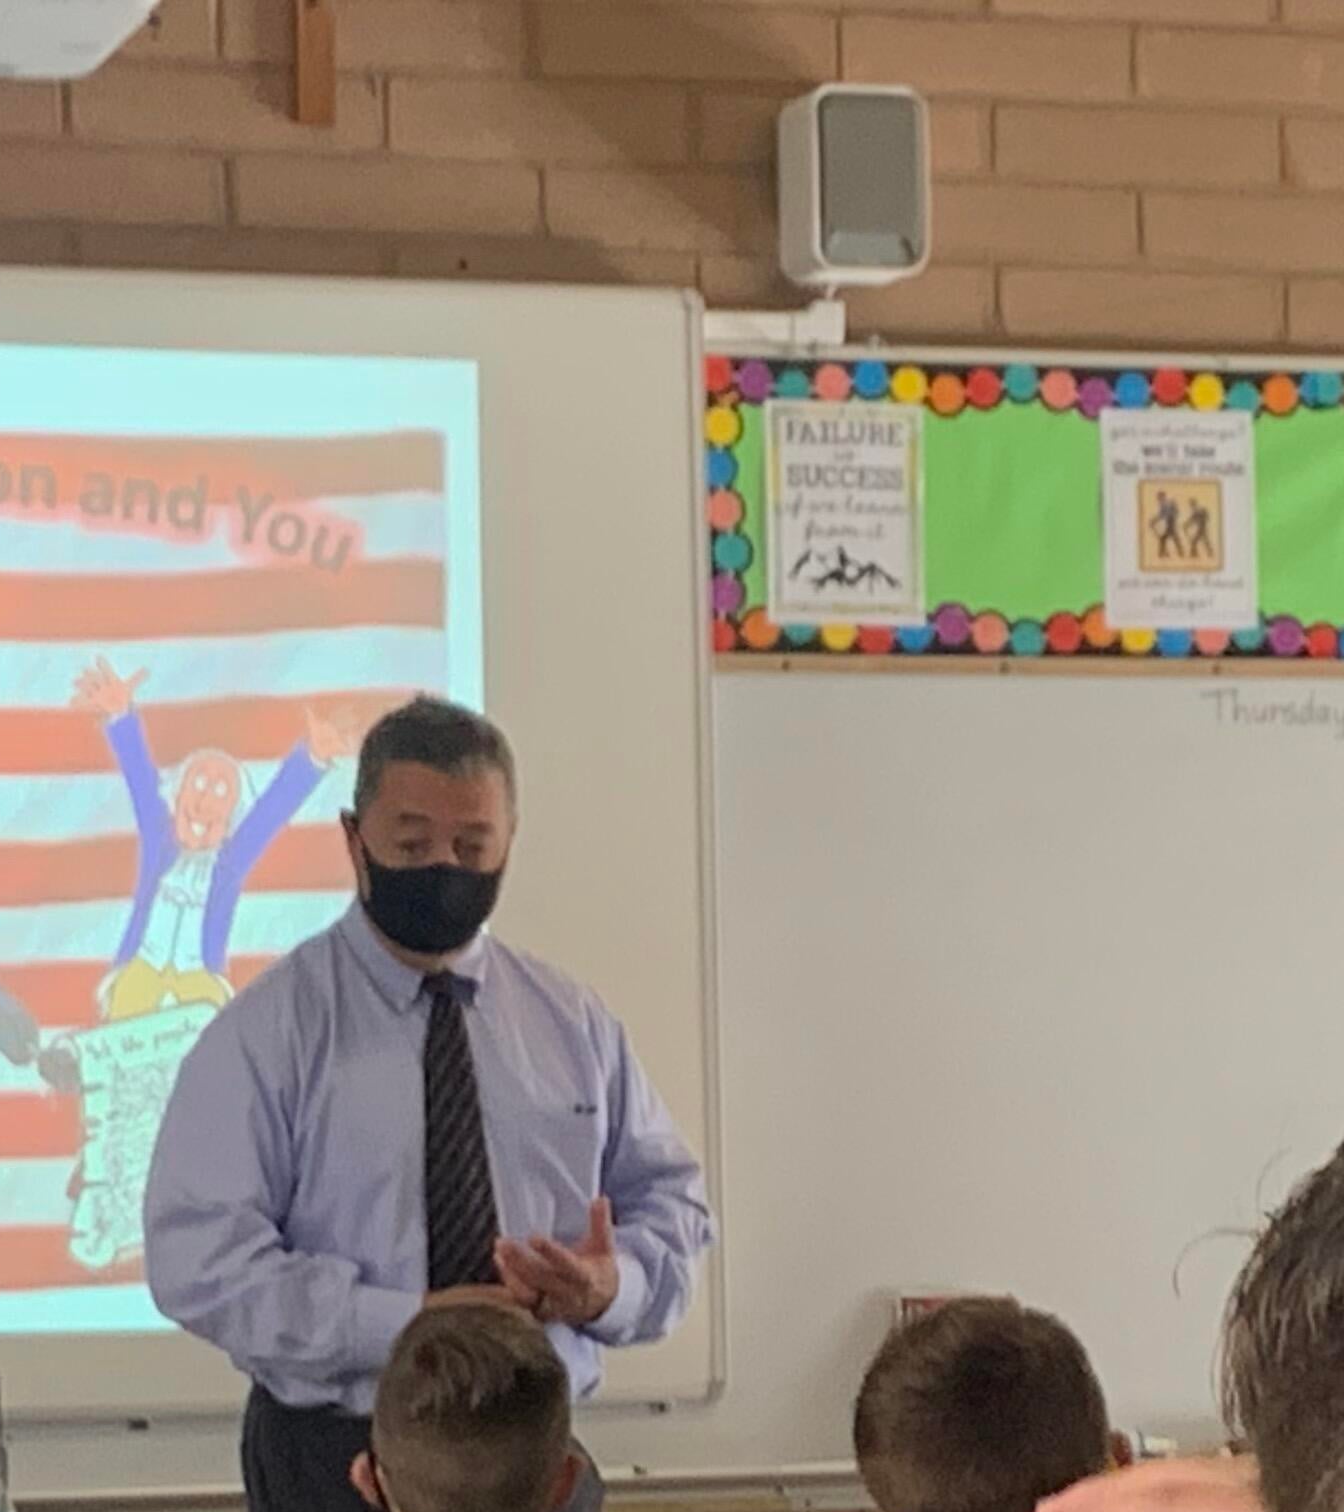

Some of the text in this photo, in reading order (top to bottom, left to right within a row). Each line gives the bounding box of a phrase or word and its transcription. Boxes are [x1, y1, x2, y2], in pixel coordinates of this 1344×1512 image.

[787, 419, 904, 447] FAILURE
[787, 464, 905, 491] SUCCESS
[78, 472, 208, 534] and
[230, 482, 355, 574] You
